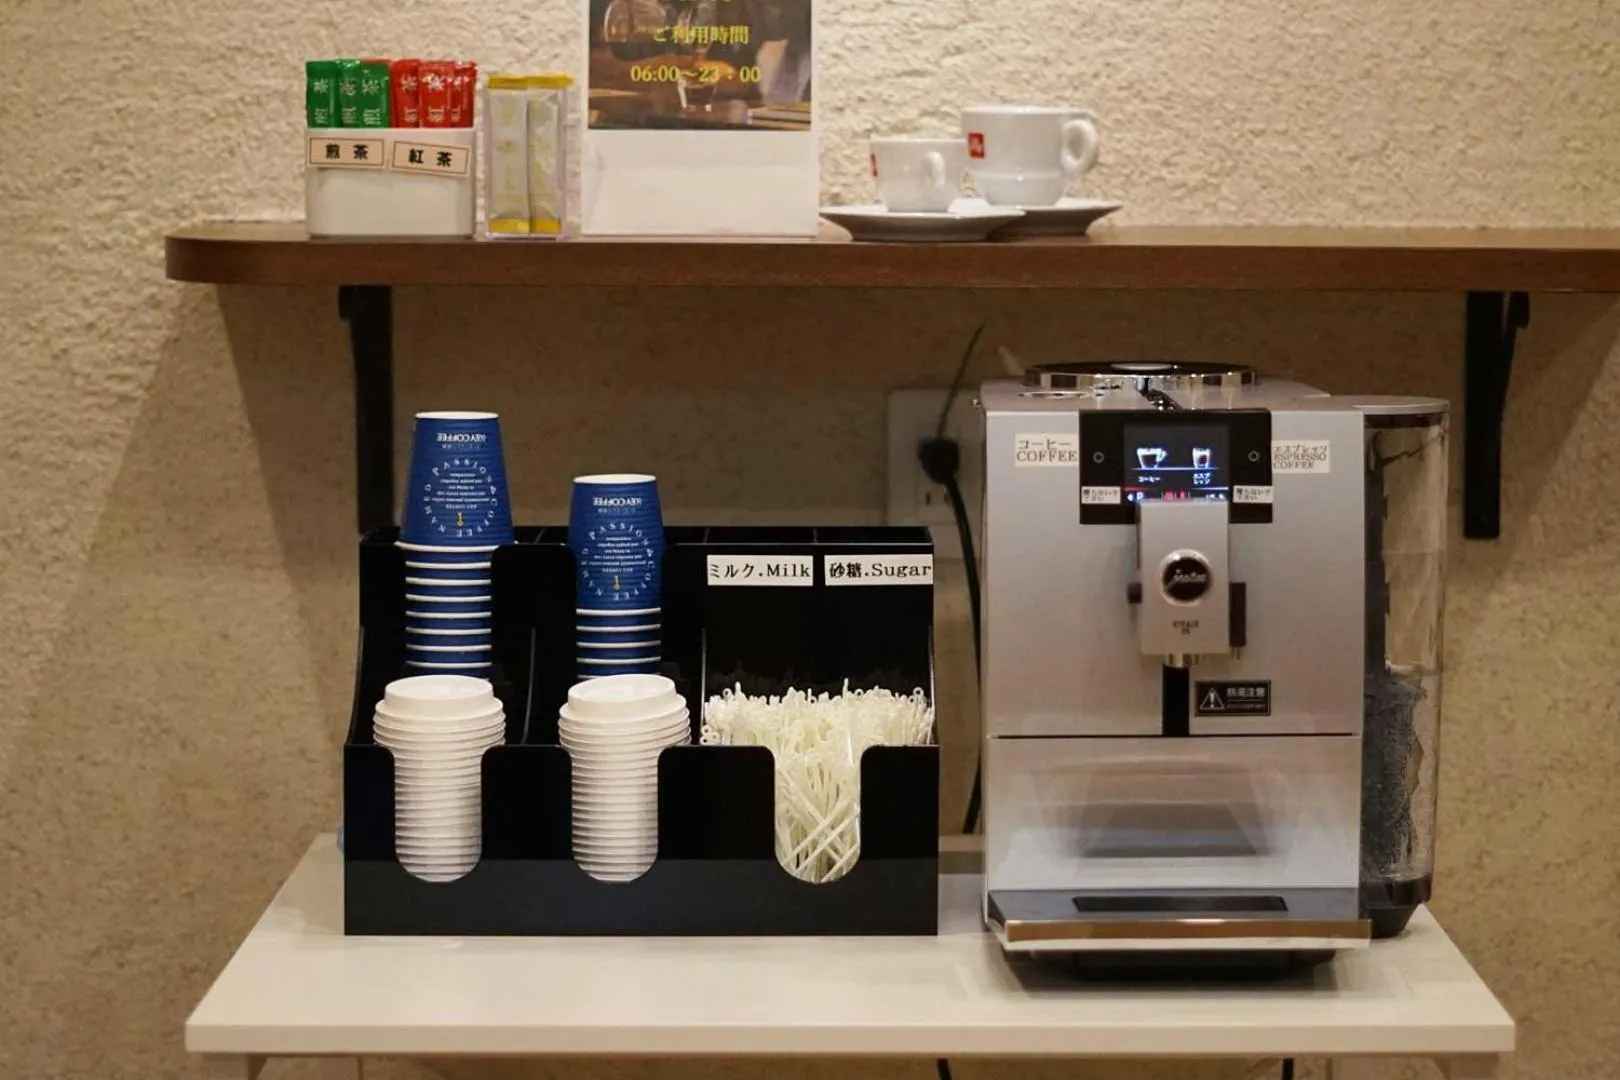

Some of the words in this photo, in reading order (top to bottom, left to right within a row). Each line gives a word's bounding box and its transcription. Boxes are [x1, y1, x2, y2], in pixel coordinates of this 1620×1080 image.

[653, 25, 749, 44] ご利用時間
[1017, 439, 1072, 450] コーヒー
[1016, 450, 1077, 461] COFFEE
